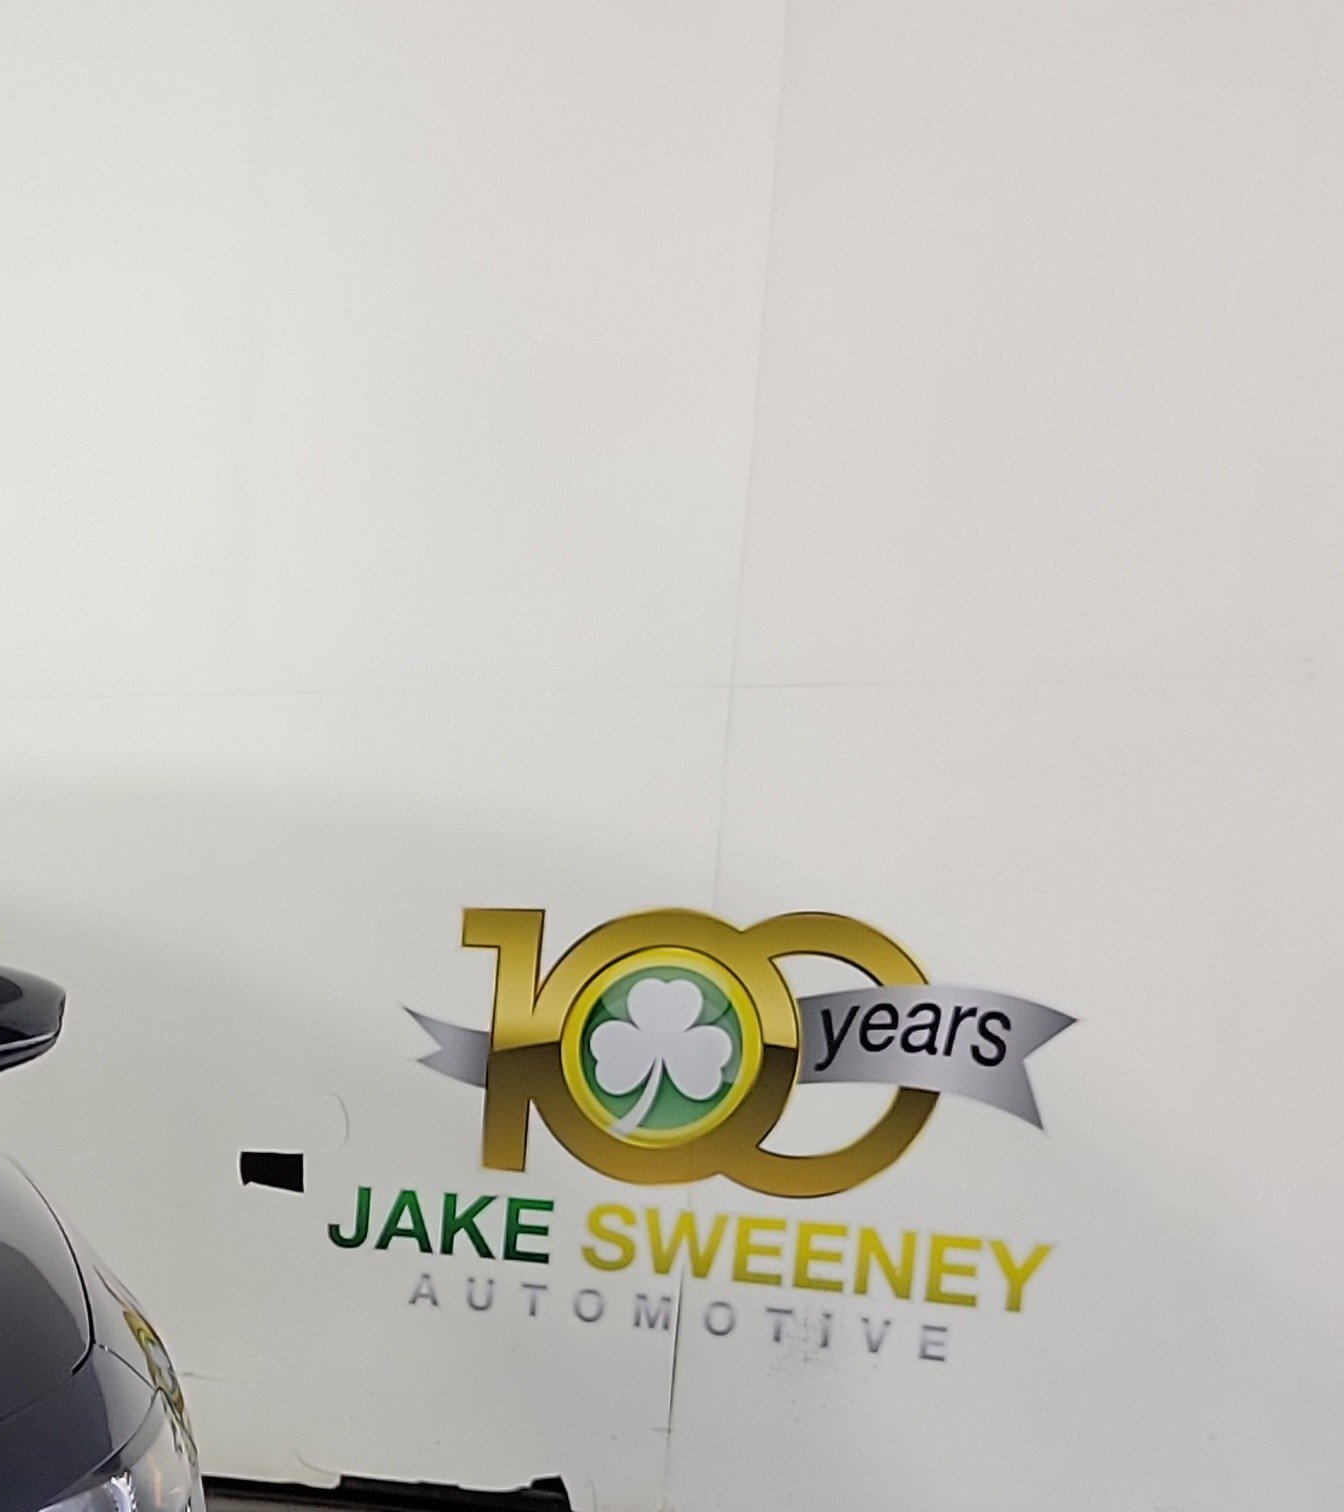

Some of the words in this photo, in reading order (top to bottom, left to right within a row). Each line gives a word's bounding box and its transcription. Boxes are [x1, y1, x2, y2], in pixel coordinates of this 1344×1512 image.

[462, 907, 941, 1199] 100
[814, 1000, 1013, 1072] years
[327, 1186, 555, 1265] JAKE
[581, 1201, 1053, 1313] SWEENEY
[408, 1273, 950, 1361] AUTOMOTIVE
